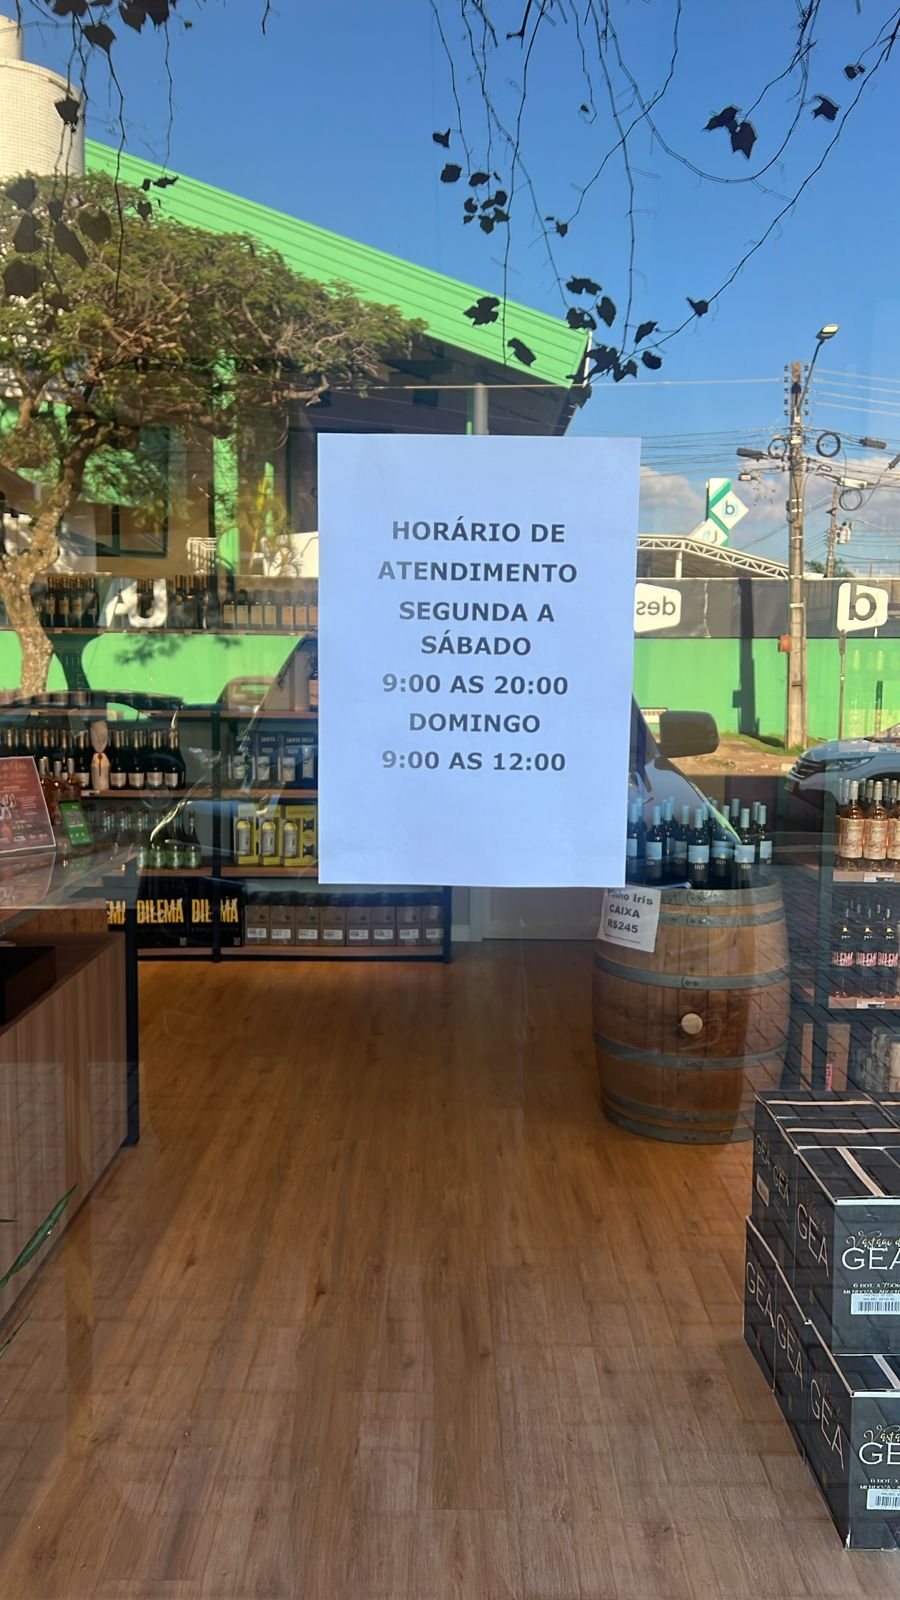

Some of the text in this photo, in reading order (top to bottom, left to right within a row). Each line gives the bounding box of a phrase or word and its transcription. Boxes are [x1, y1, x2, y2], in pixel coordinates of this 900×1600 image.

[393, 515, 566, 543] HORÁRIO DE
[378, 561, 578, 583] ATENDIMENTO
[399, 601, 555, 622] SEGUNDA A
[421, 629, 532, 656] SÁBADO
[382, 674, 568, 696] 9:00 AS 20:00
[410, 713, 541, 733] DOMINGO
[381, 750, 567, 772] 9:00 AS 12:00
[136, 898, 185, 925] DILEMA
[191, 897, 239, 924] DILMA
[609, 903, 641, 919] CAIXA
[773, 1164, 790, 1207] GEA
[797, 1203, 830, 1278] GEA
[746, 1261, 775, 1329] GEA
[776, 1313, 804, 1393] GEA
[810, 1378, 845, 1471] GEA
